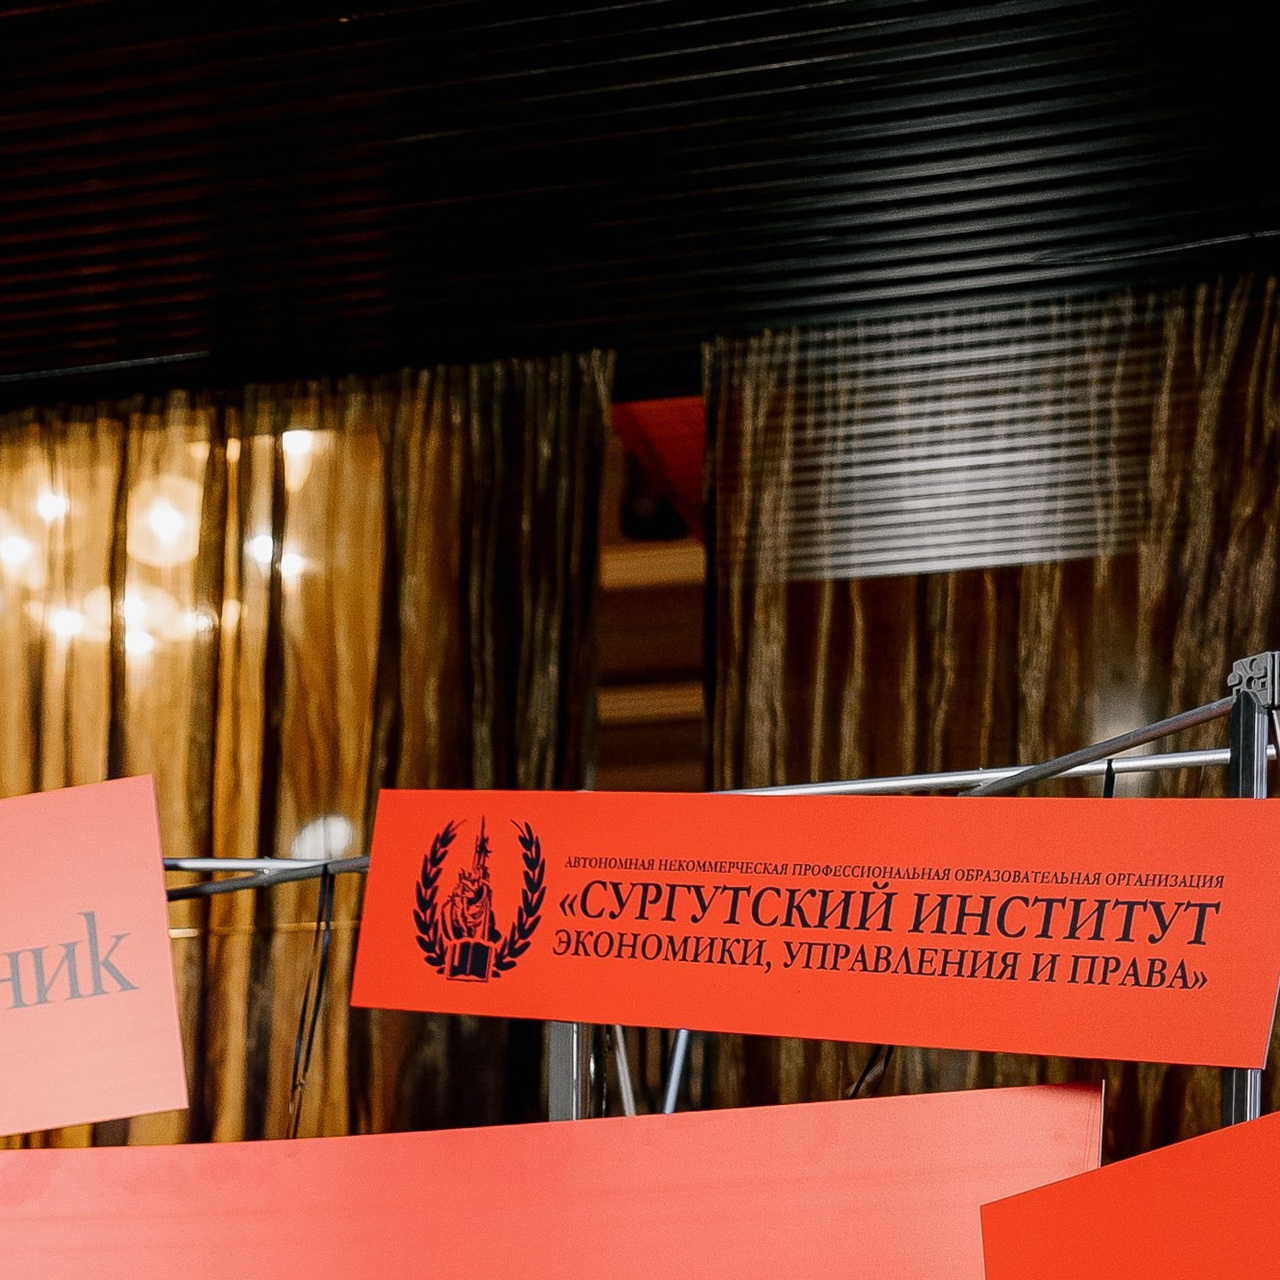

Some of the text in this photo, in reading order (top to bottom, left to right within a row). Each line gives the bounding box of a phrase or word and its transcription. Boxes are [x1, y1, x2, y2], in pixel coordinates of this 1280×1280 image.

[564, 855, 1225, 889] АВТОНОМНАЯ НЕКОММЕРЧЕСКАЯ ПРОФЕССИОНАЛЬНАЯ ОБРАЗОВАТЕЛЬНАЯ ОРГАНИЗАЦИЯ
[558, 879, 1221, 946] «СУРГУТСКИЙ ИНСТИТУТ
[552, 928, 1209, 990] ЭКОНОМИКИ, УПРАВЛЕНИЯ И ПРАВА»
